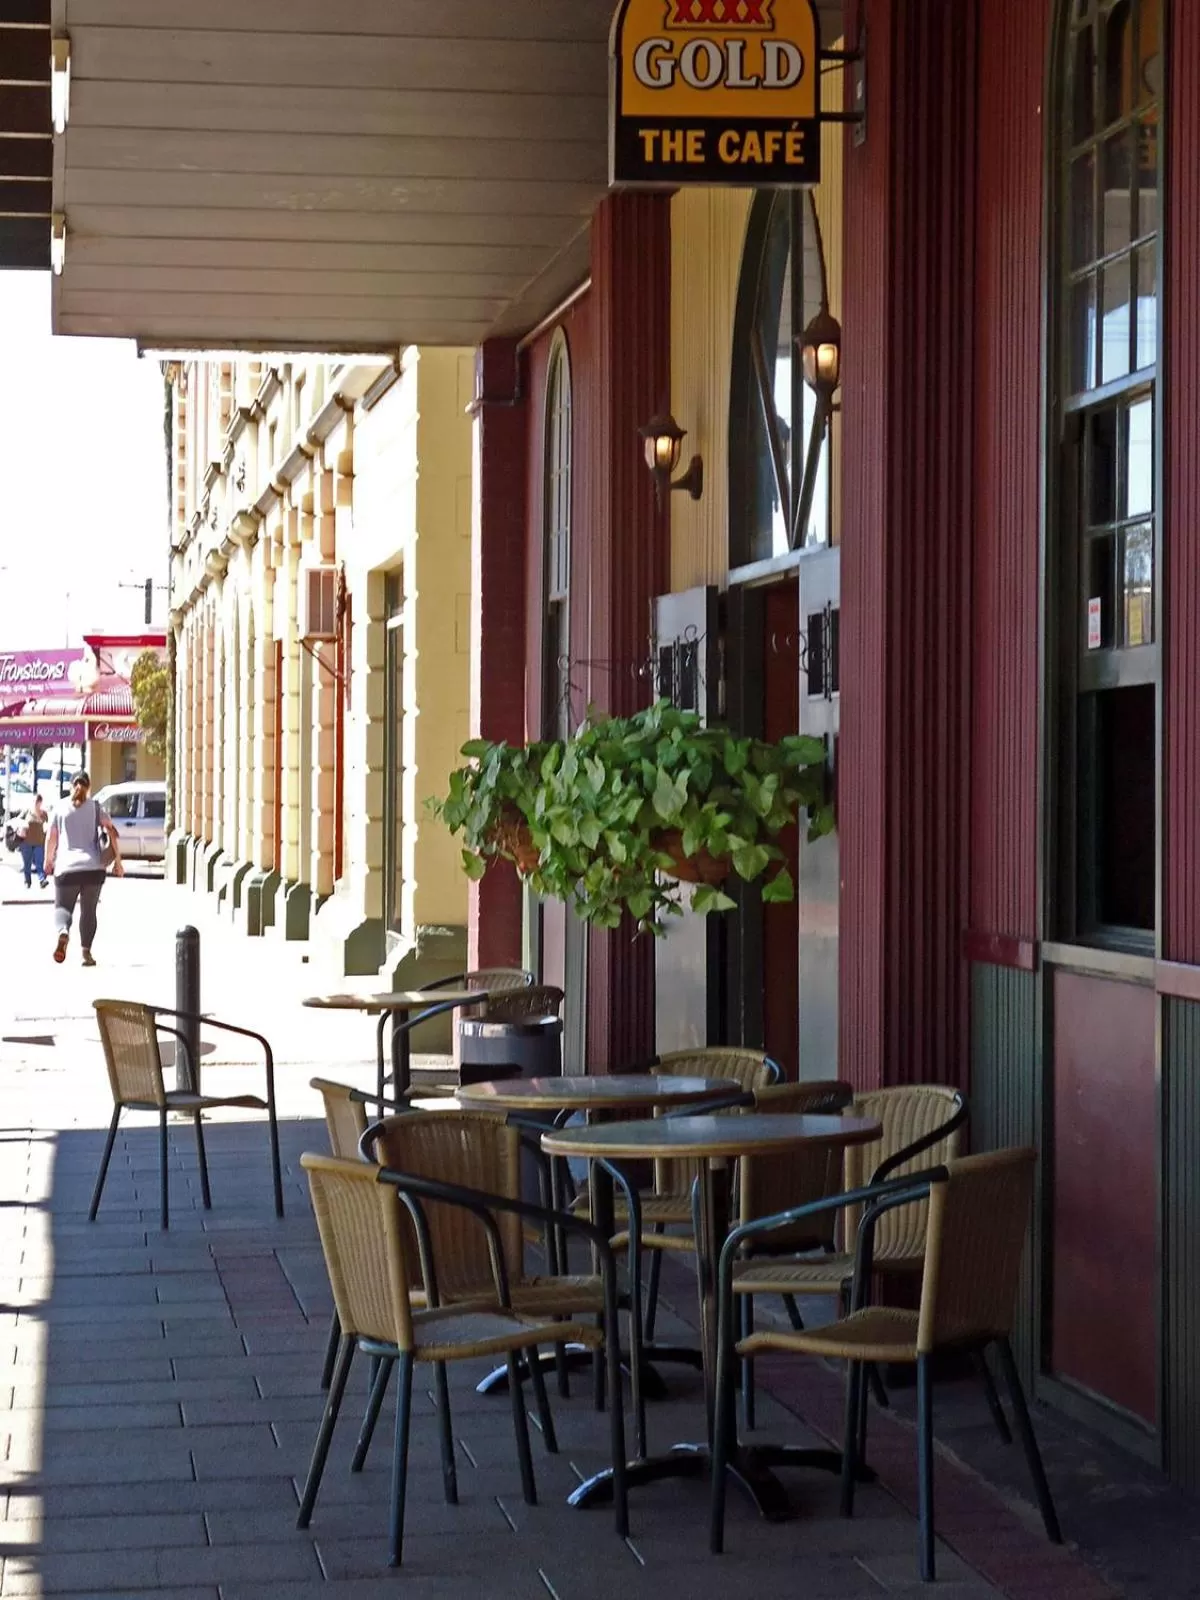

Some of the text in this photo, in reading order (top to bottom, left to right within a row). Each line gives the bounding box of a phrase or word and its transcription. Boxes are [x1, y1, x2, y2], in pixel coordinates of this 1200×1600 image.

[634, 38, 803, 89] GOLD
[638, 121, 805, 164] THE CAFÉ
[0, 655, 65, 681] Transitions
